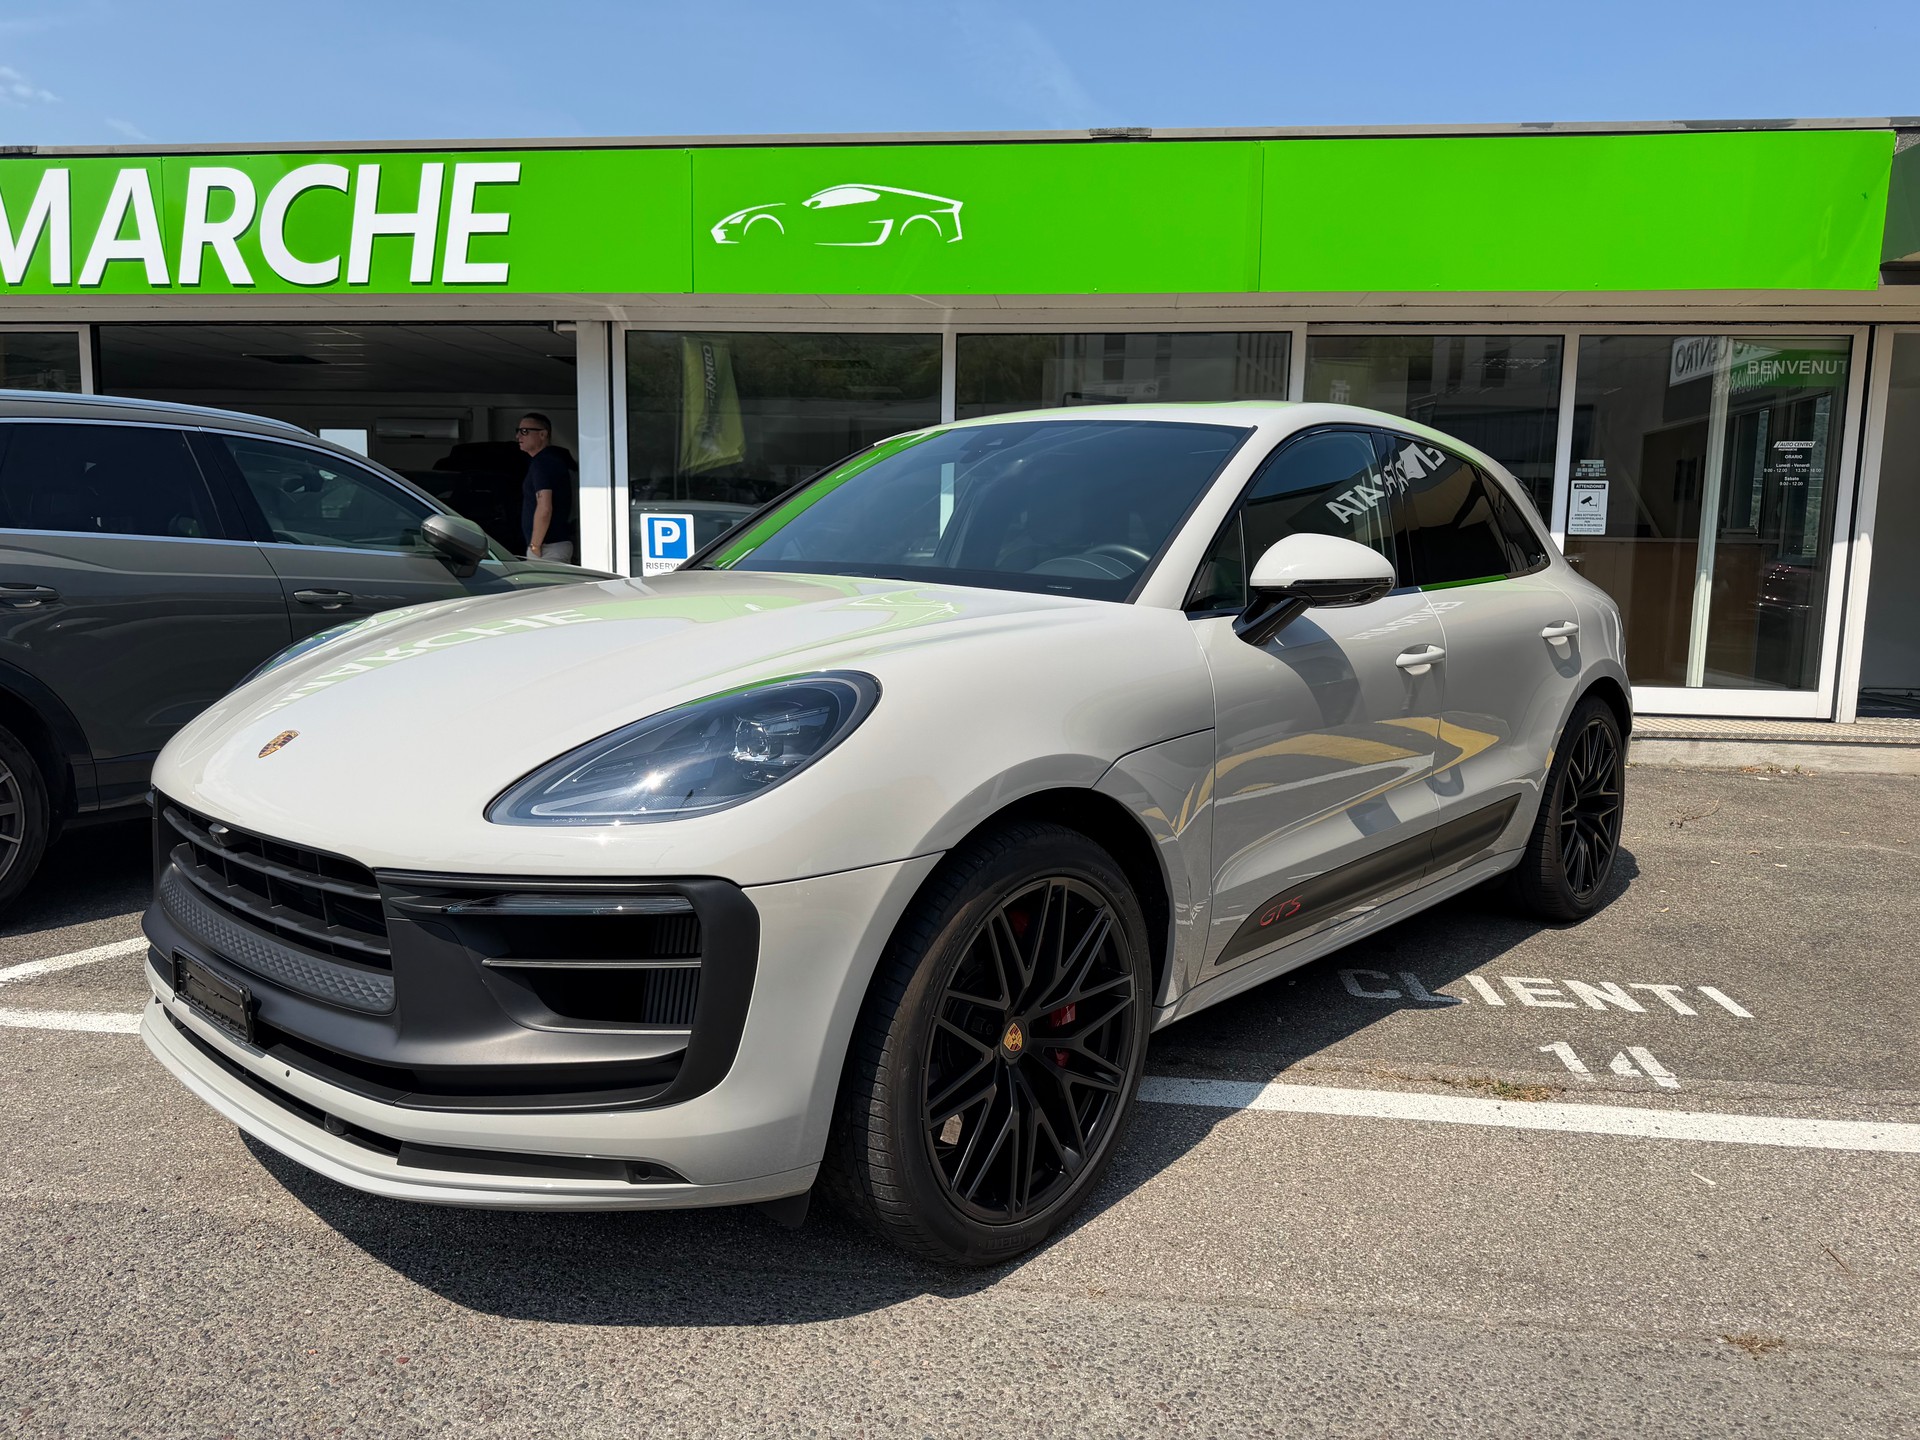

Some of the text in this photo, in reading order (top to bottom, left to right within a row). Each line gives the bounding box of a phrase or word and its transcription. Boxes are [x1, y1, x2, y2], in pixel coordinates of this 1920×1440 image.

[1259, 895, 1303, 927] GTS
[1339, 968, 1755, 1018] CLIENTI
[1538, 1041, 1682, 1089] 14
